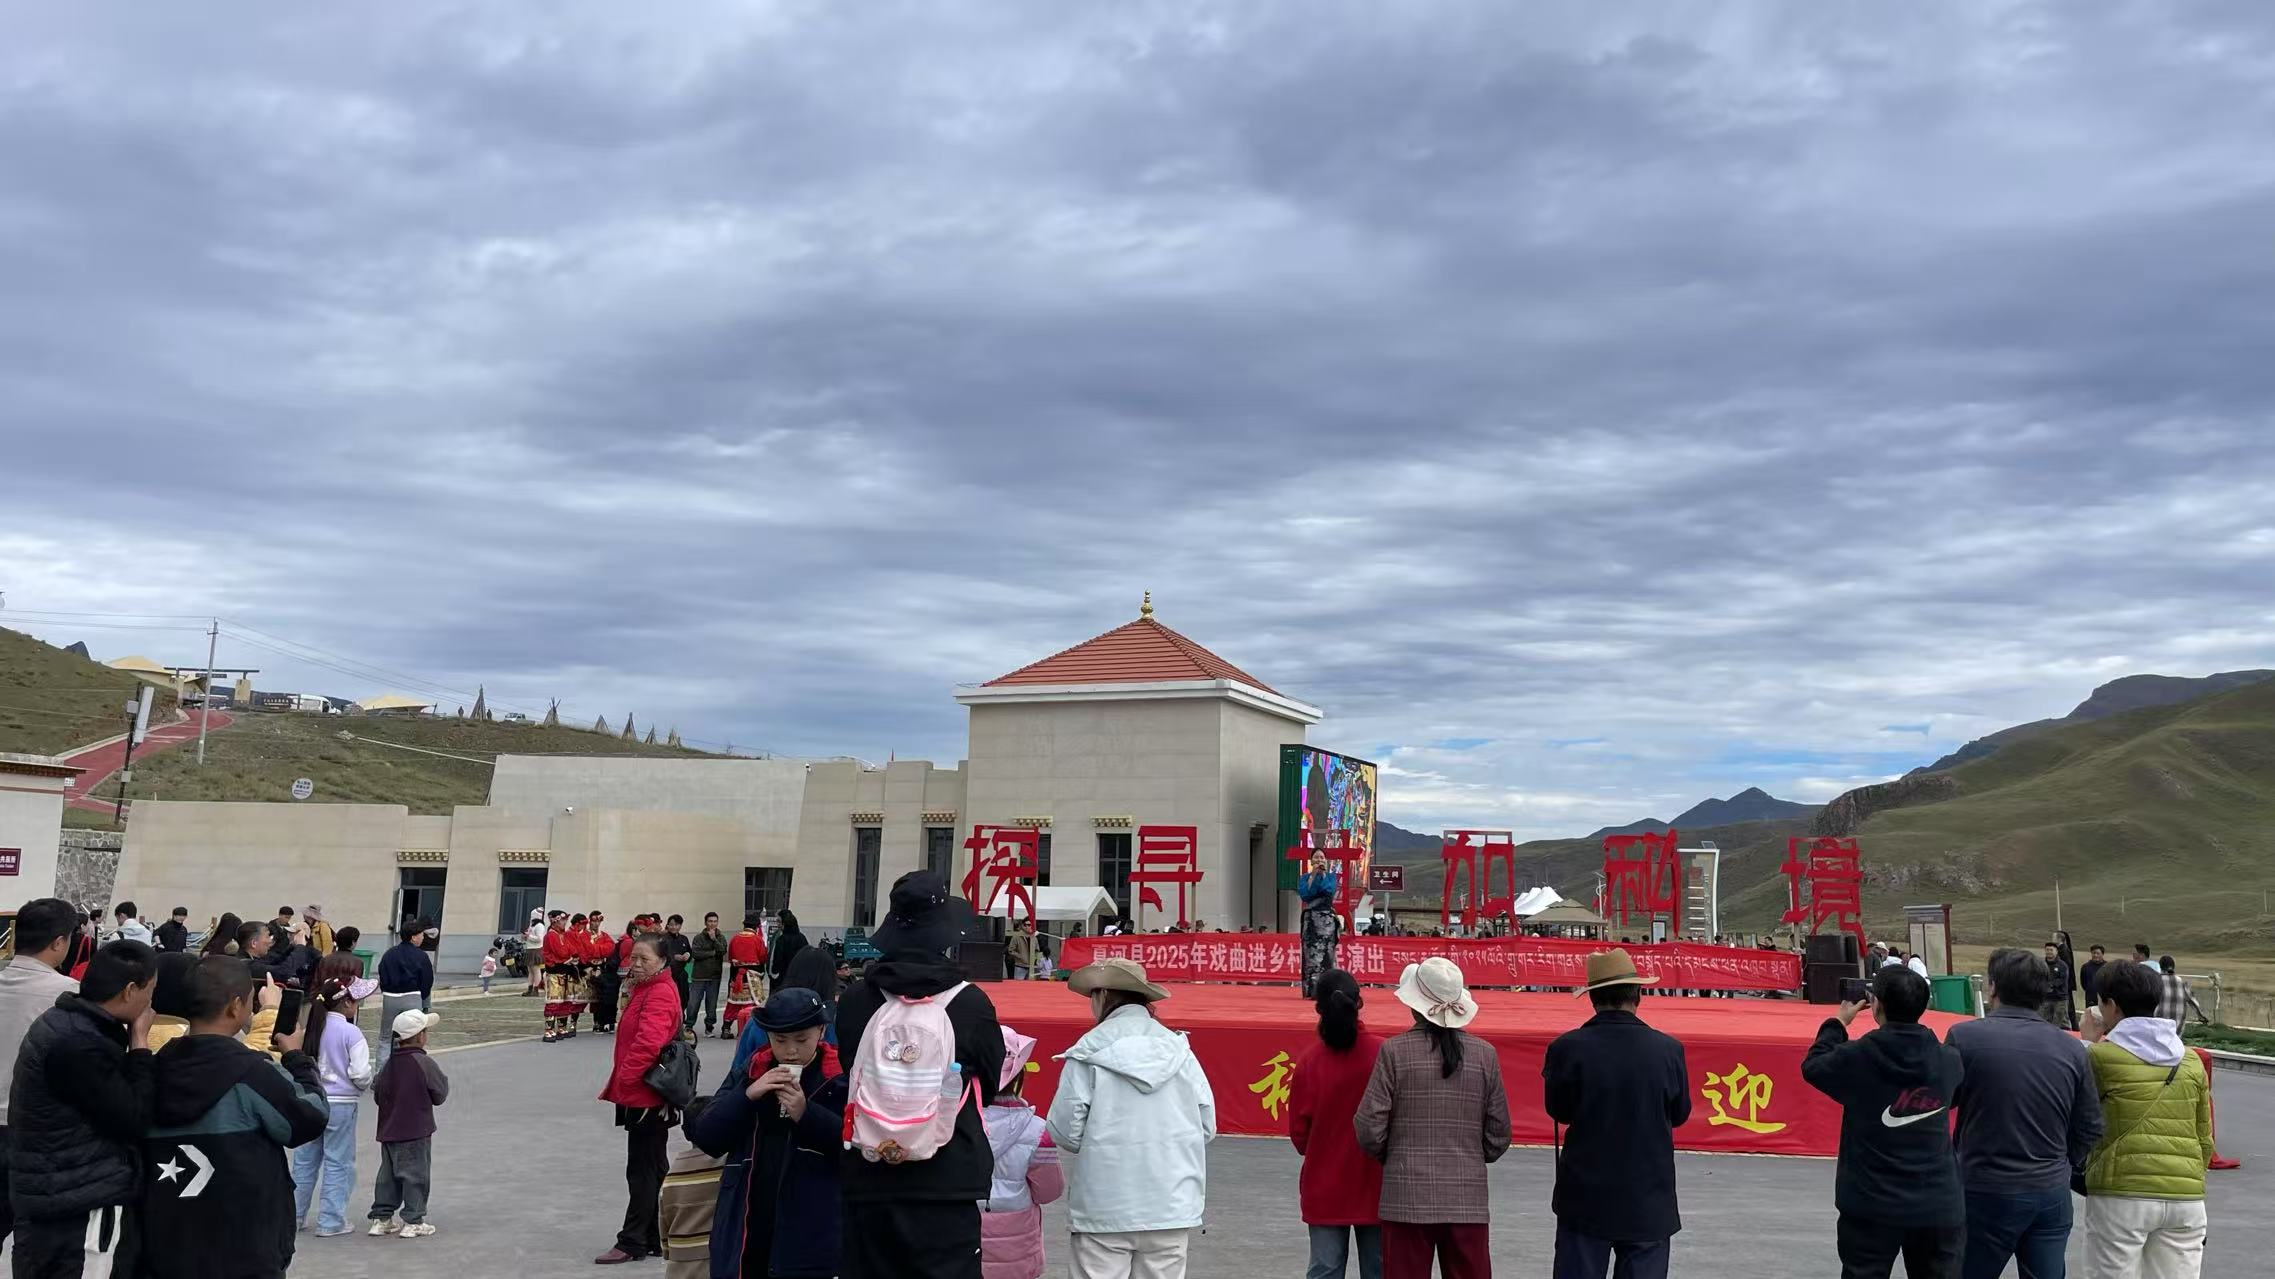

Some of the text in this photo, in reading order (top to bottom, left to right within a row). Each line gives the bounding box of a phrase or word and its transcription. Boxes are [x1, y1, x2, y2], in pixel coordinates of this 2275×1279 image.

[1373, 870, 1399, 878] 卫生间
[1091, 941, 1385, 974] 夏河县2025年戏曲进乡村民演出
[1701, 1062, 1787, 1133] 迎
